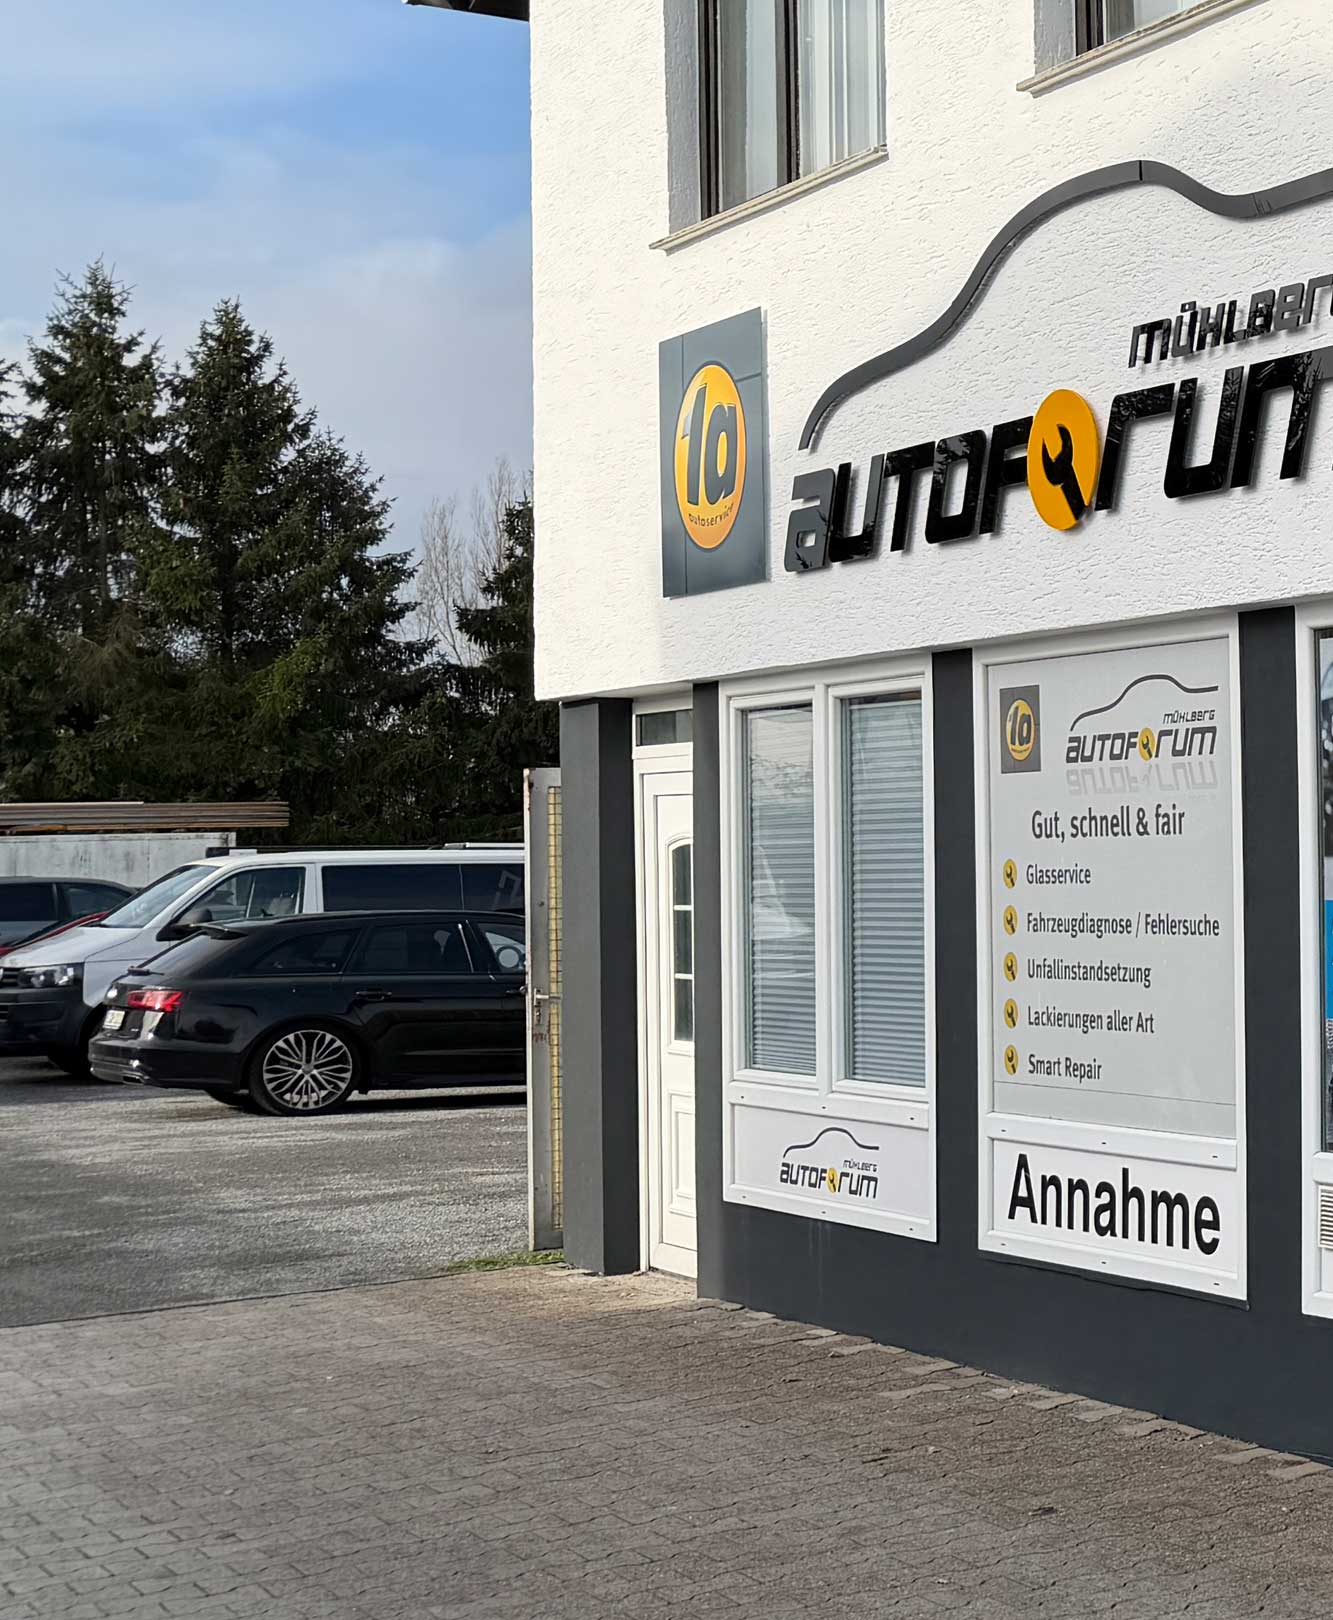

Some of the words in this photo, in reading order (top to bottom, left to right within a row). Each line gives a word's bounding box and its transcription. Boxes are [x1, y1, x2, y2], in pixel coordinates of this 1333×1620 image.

[688, 500, 735, 530] autoservice
[1032, 810, 1065, 843] Gut,
[1071, 806, 1131, 838] schnell
[1136, 808, 1149, 836] &
[1156, 804, 1185, 836] fair
[1027, 864, 1091, 884] Glasservice
[1027, 912, 1132, 939] Fahrzeugdiagnose
[1144, 913, 1220, 937] Fehlersuche
[1027, 958, 1151, 987] Unfallinstandsetzung
[1028, 1006, 1102, 1035] Lackierungen
[1106, 1010, 1133, 1033] aller
[1136, 1012, 1155, 1034] Art
[1028, 1054, 1061, 1078] Smart
[1065, 1057, 1102, 1084] Repair
[1008, 1153, 1221, 1255] Annahme
